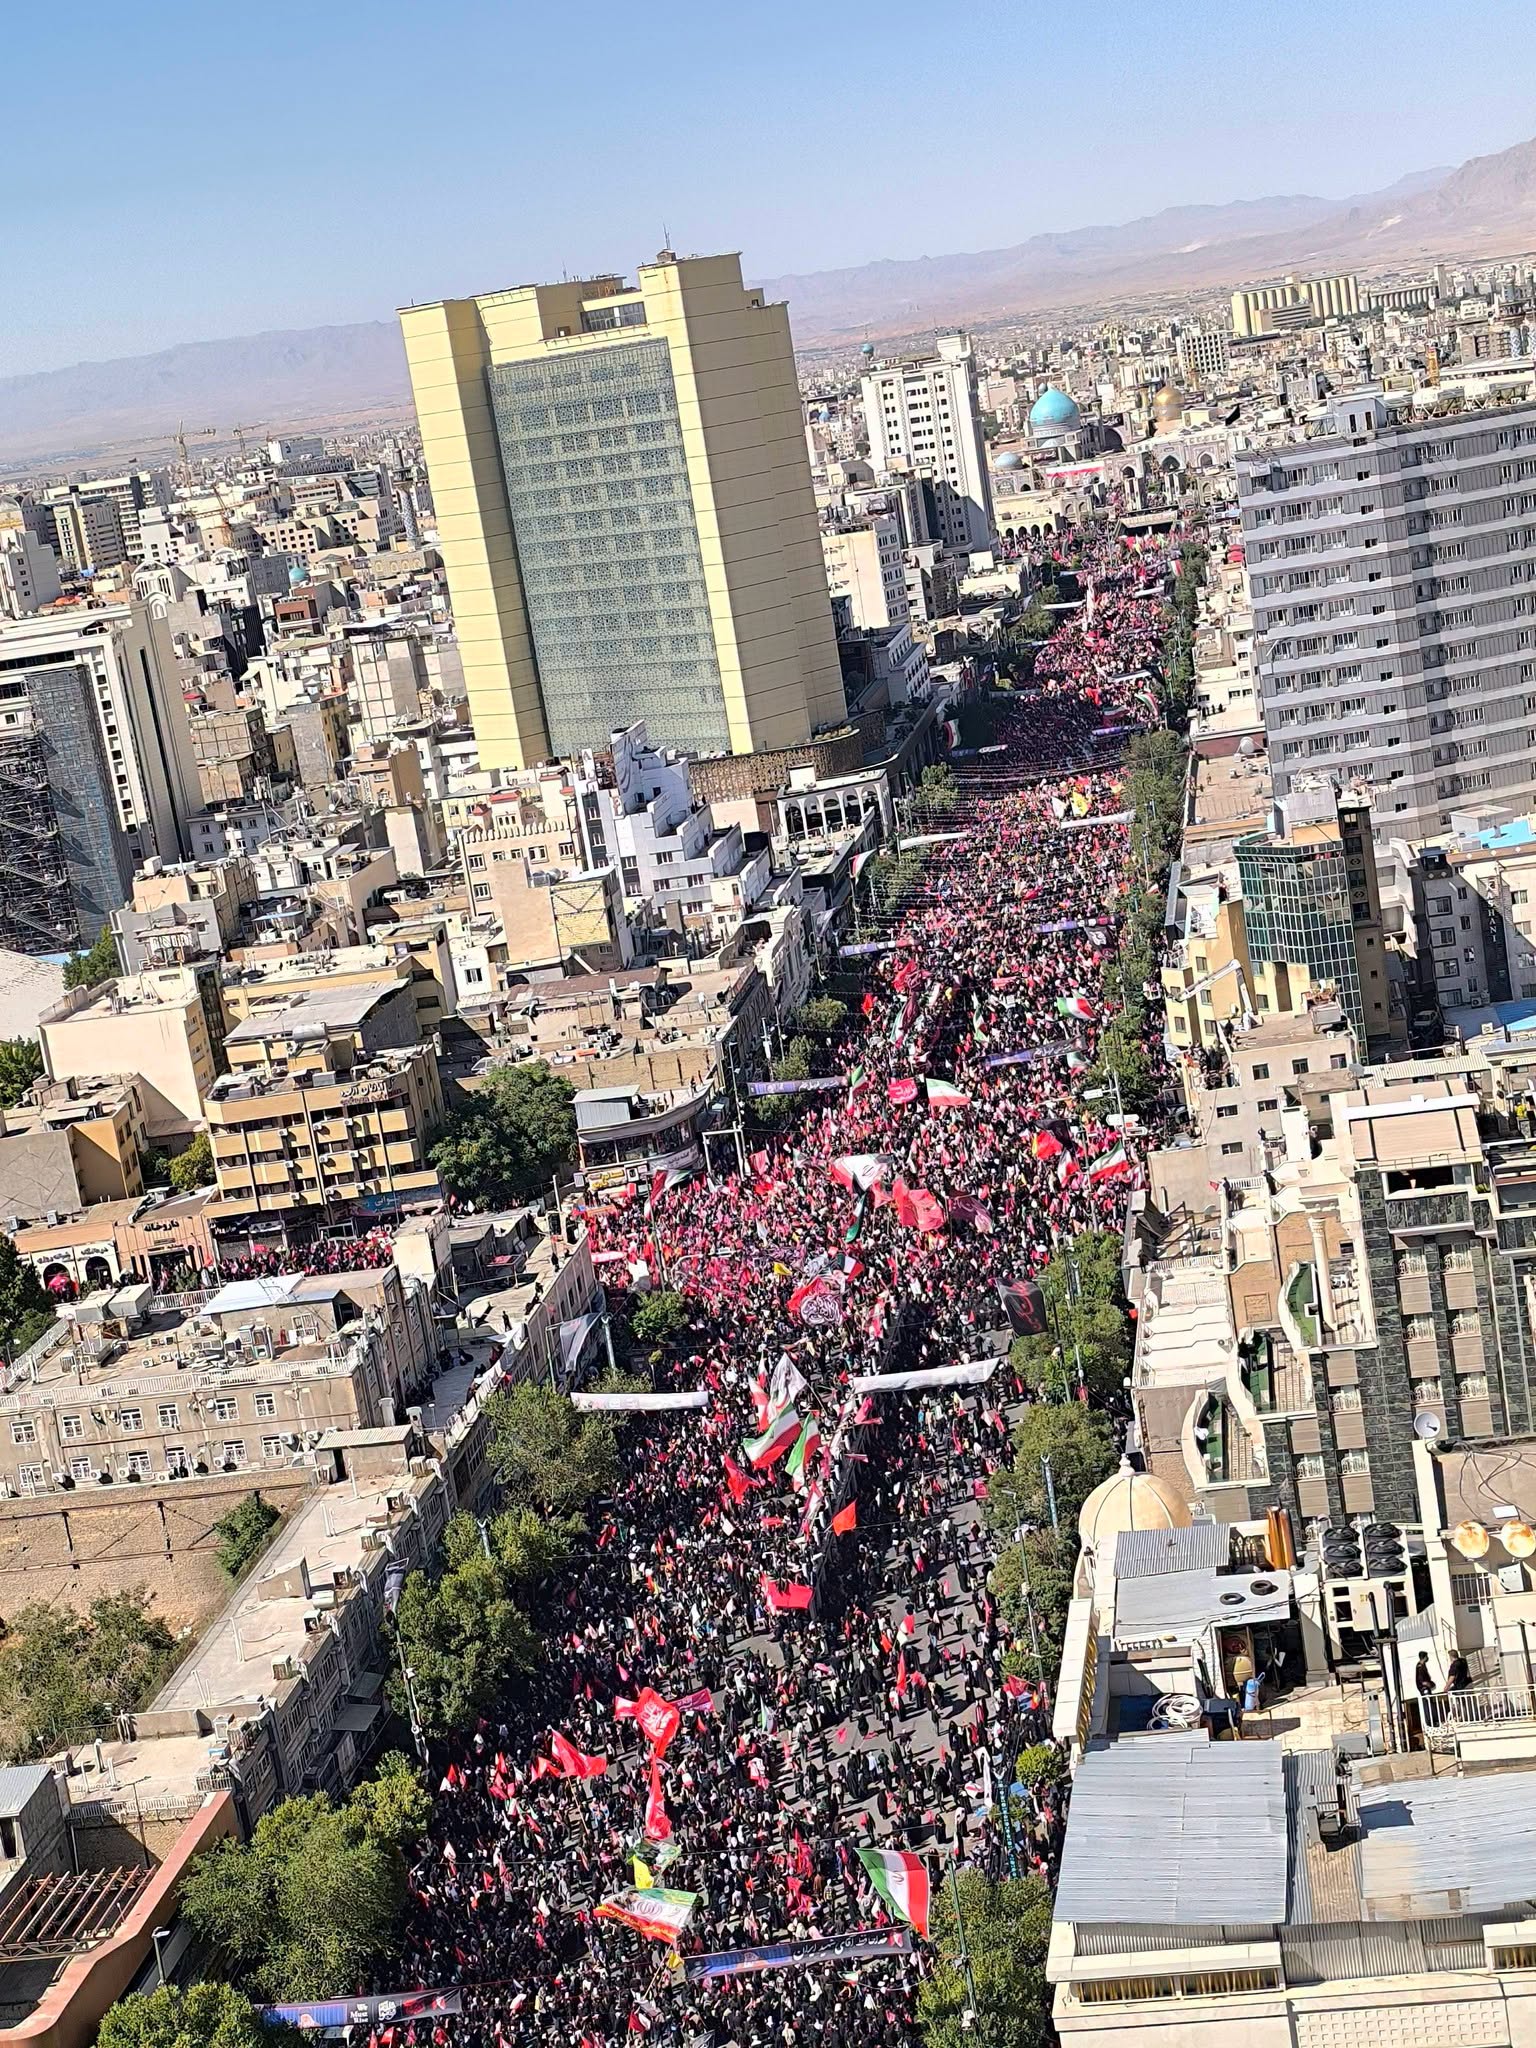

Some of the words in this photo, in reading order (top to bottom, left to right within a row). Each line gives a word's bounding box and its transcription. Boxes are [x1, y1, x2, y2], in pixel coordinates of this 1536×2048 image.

[1486, 881, 1497, 942] KASHANI
[144, 1220, 180, 1232] داروخانه
[792, 1943, 817, 1961] ایران
